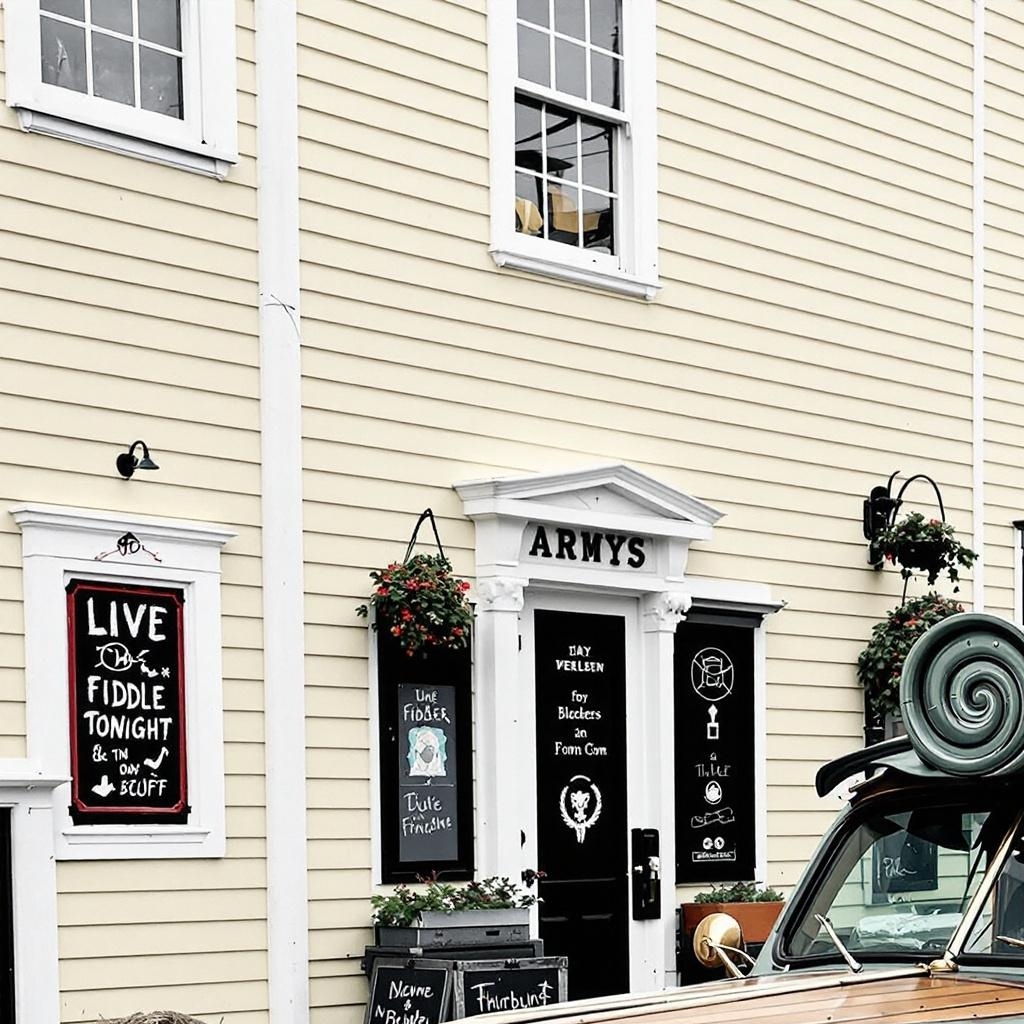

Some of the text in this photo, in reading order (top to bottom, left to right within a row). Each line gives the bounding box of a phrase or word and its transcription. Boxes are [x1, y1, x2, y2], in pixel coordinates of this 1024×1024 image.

[528, 525, 646, 569] ARMYS
[87, 597, 168, 642] LIVE
[87, 676, 166, 711] FIDDLE
[83, 711, 173, 741] TONIGHT
